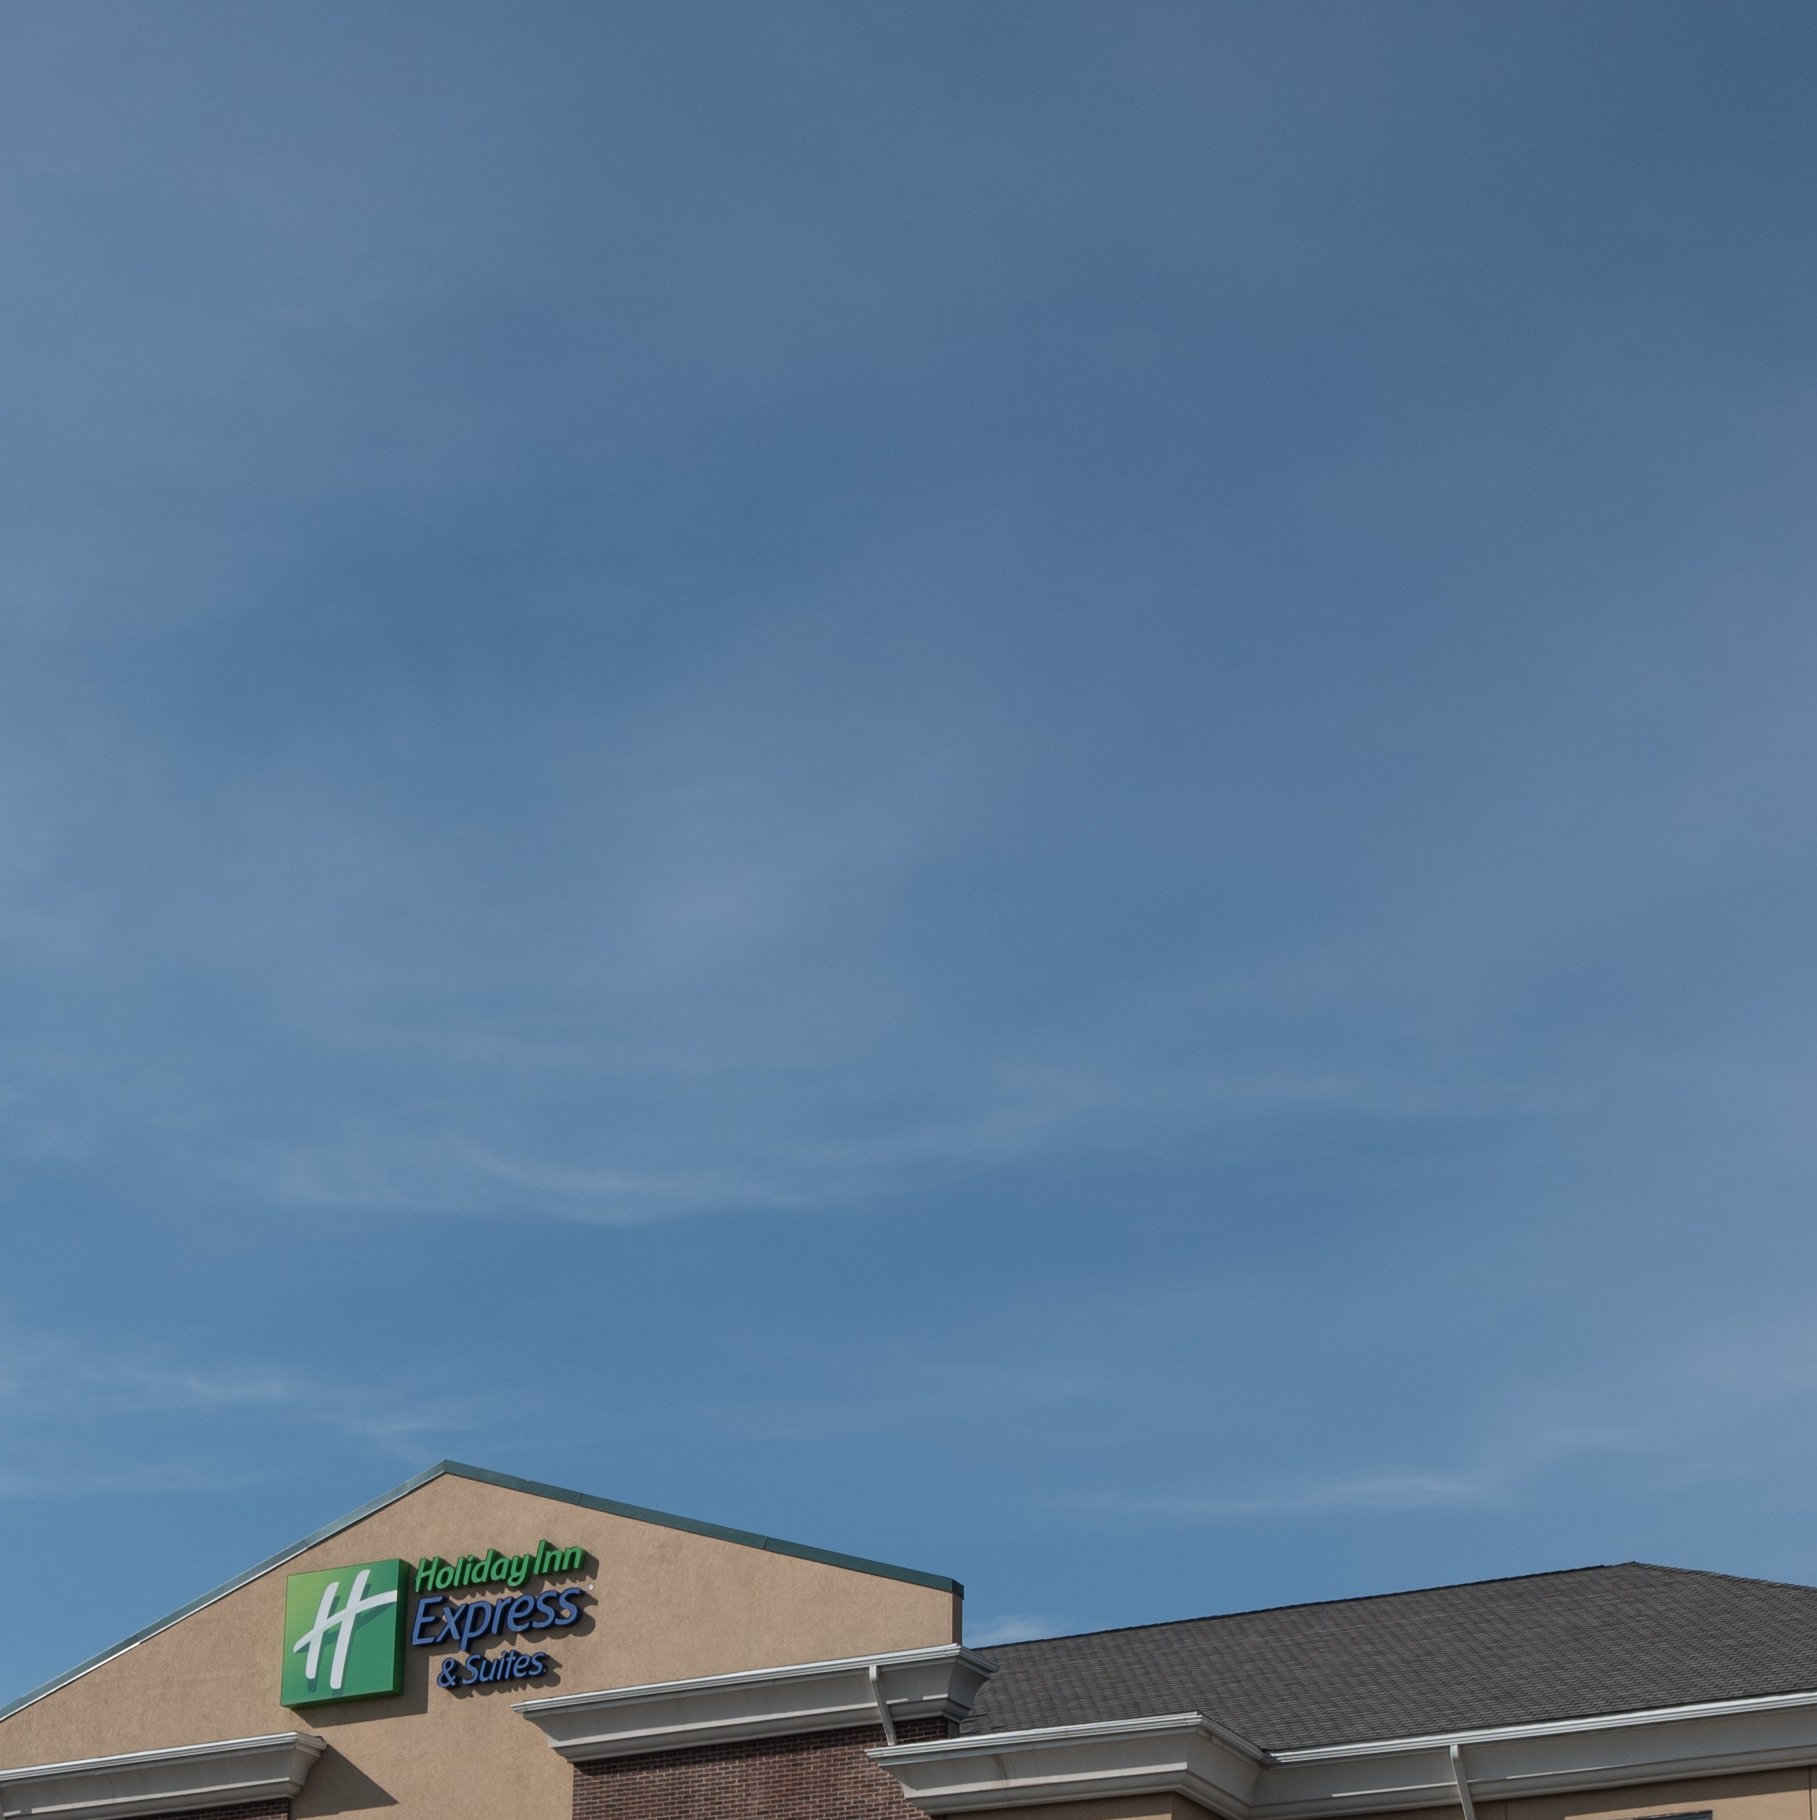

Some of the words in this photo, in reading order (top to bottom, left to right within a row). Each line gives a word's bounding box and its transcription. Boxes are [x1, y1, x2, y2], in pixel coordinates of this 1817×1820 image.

[414, 1548, 531, 1593] Holiday
[533, 1539, 583, 1575] Inn
[412, 1587, 582, 1652] Express
[437, 1657, 456, 1687] &
[462, 1649, 546, 1685] Suites
